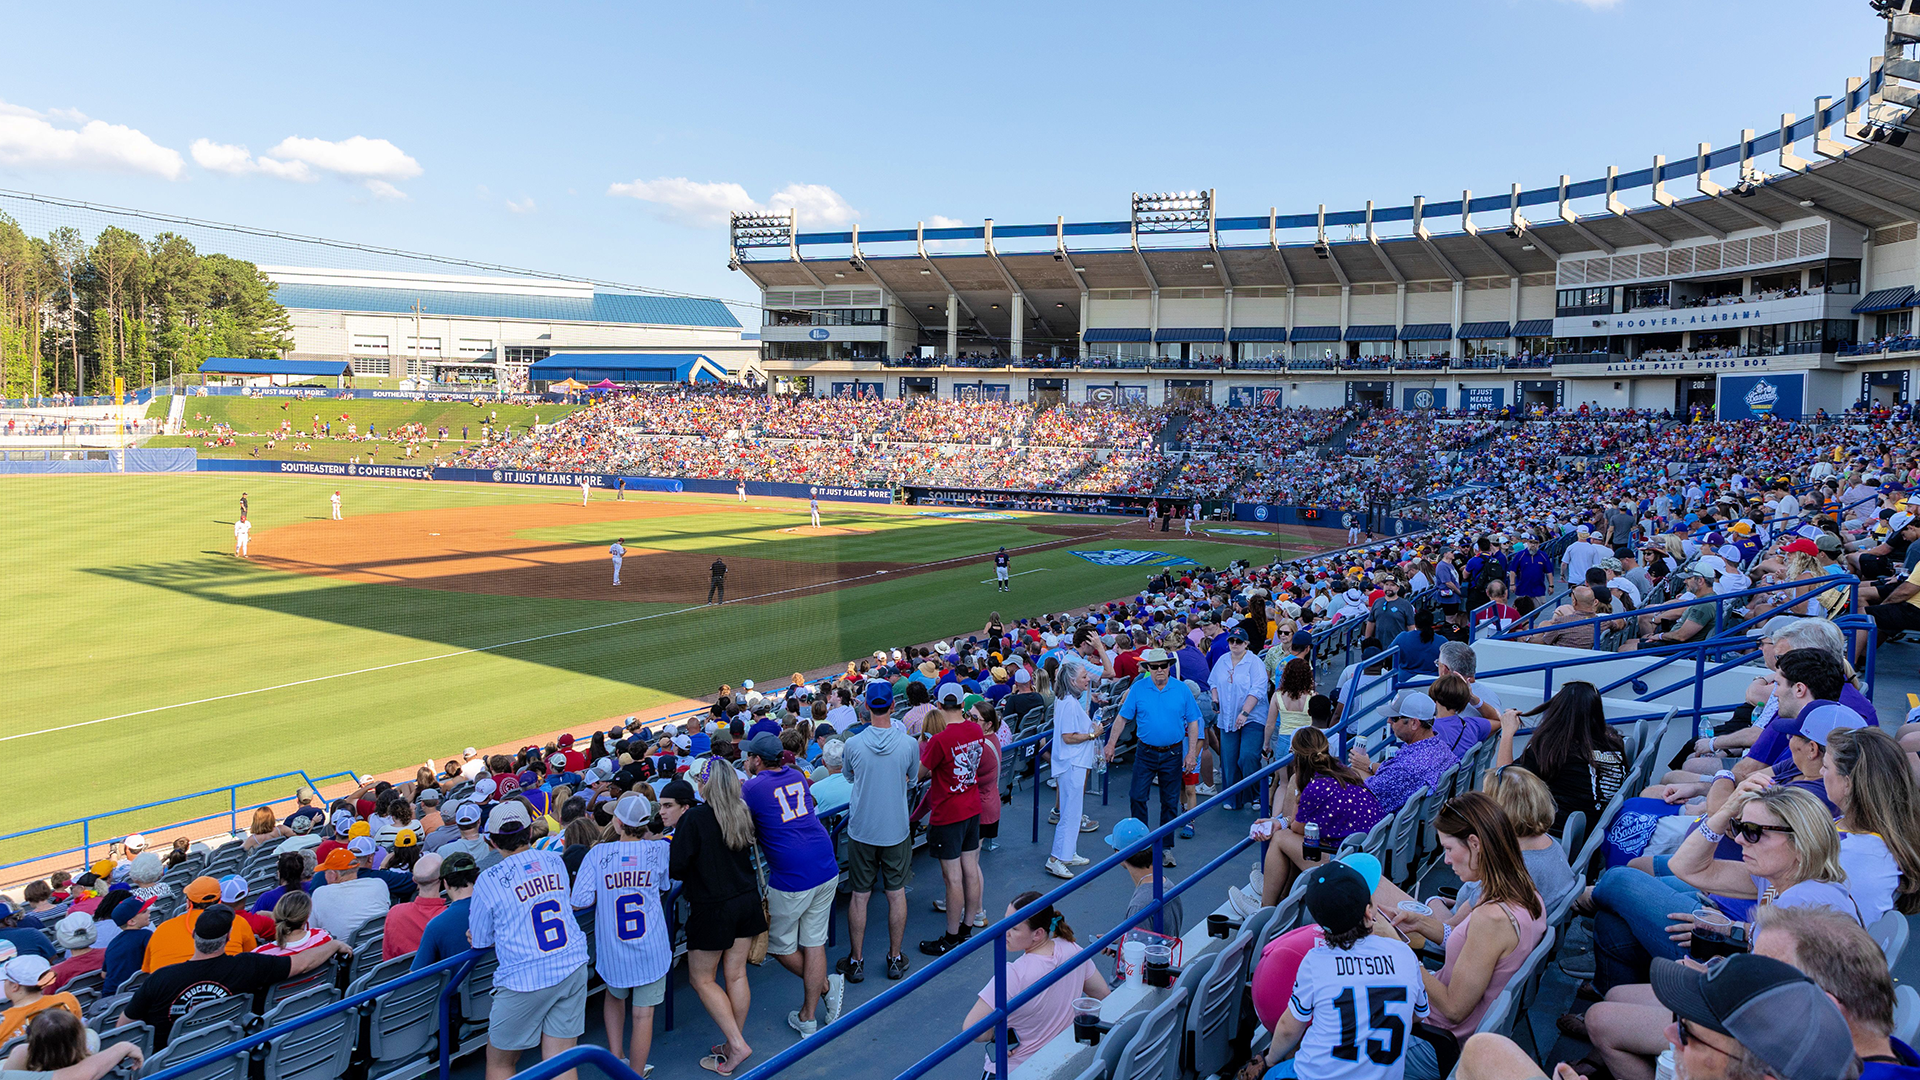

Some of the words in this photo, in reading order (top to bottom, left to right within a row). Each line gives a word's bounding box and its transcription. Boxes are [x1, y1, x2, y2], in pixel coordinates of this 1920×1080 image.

[1617, 317, 1684, 328] HOOVER,
[1690, 310, 1761, 324] ALABAMA
[1607, 363, 1645, 371] ALLEN
[1654, 362, 1684, 370] PATE
[1698, 360, 1736, 369] PRESS
[1744, 358, 1768, 367] BOX
[261, 388, 278, 396] JUST
[281, 462, 345, 474] SOUTHEASTERN
[358, 466, 422, 478] CONFERENCE
[504, 472, 513, 481] IT
[514, 472, 536, 483] JUST
[538, 473, 572, 485] MEANS
[819, 487, 826, 495] IT
[826, 488, 842, 496] JUST
[843, 489, 867, 497] MEANS
[773, 781, 808, 823] 17
[515, 873, 564, 903] CURIEL
[604, 871, 652, 890] CURIEL
[531, 899, 568, 953] 6
[615, 892, 646, 941] 6
[1335, 955, 1396, 976] DOTSON
[1331, 985, 1408, 1067] 15
